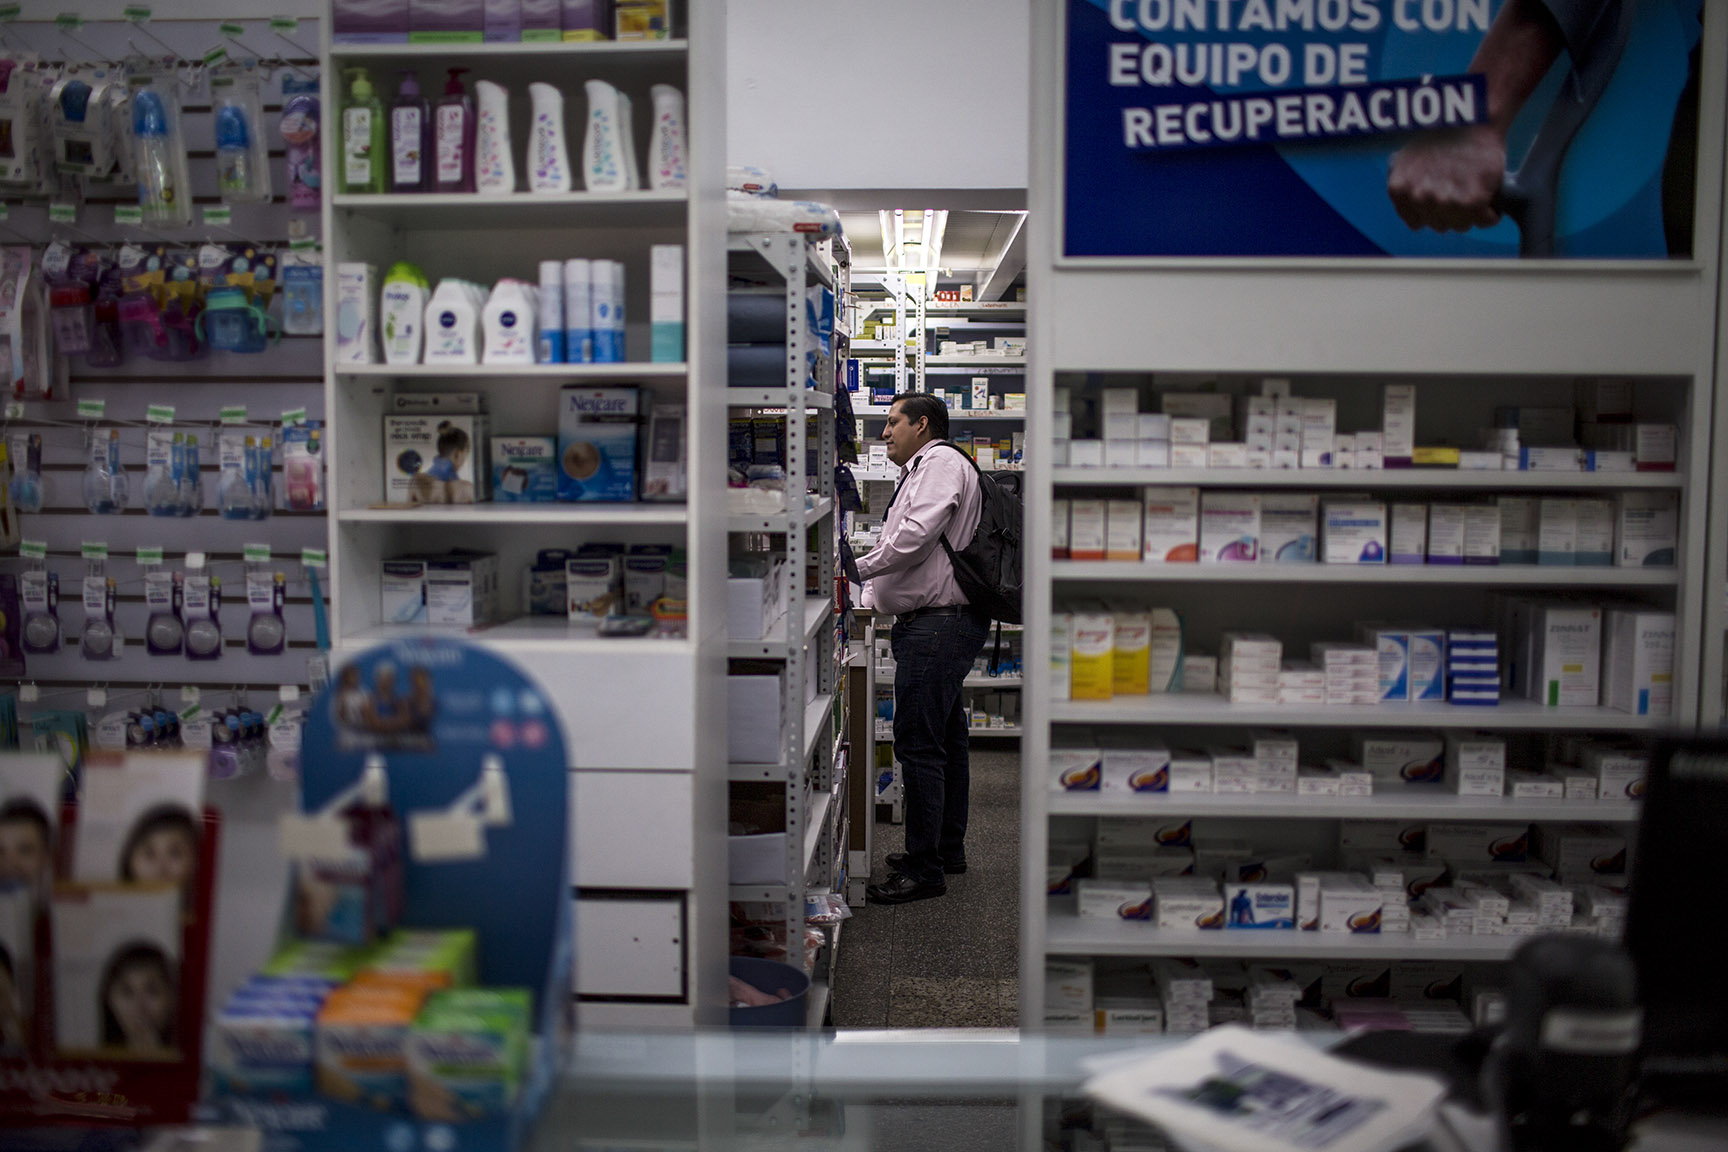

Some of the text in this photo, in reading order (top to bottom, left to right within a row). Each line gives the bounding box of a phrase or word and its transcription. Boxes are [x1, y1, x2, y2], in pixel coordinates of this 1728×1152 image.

[1109, 0, 1490, 31] CONTAMOS CON
[1109, 43, 1369, 86] EQUIPO DE
[1122, 76, 1476, 147] RECUPERACIÓN
[569, 395, 628, 412] Nexcare
